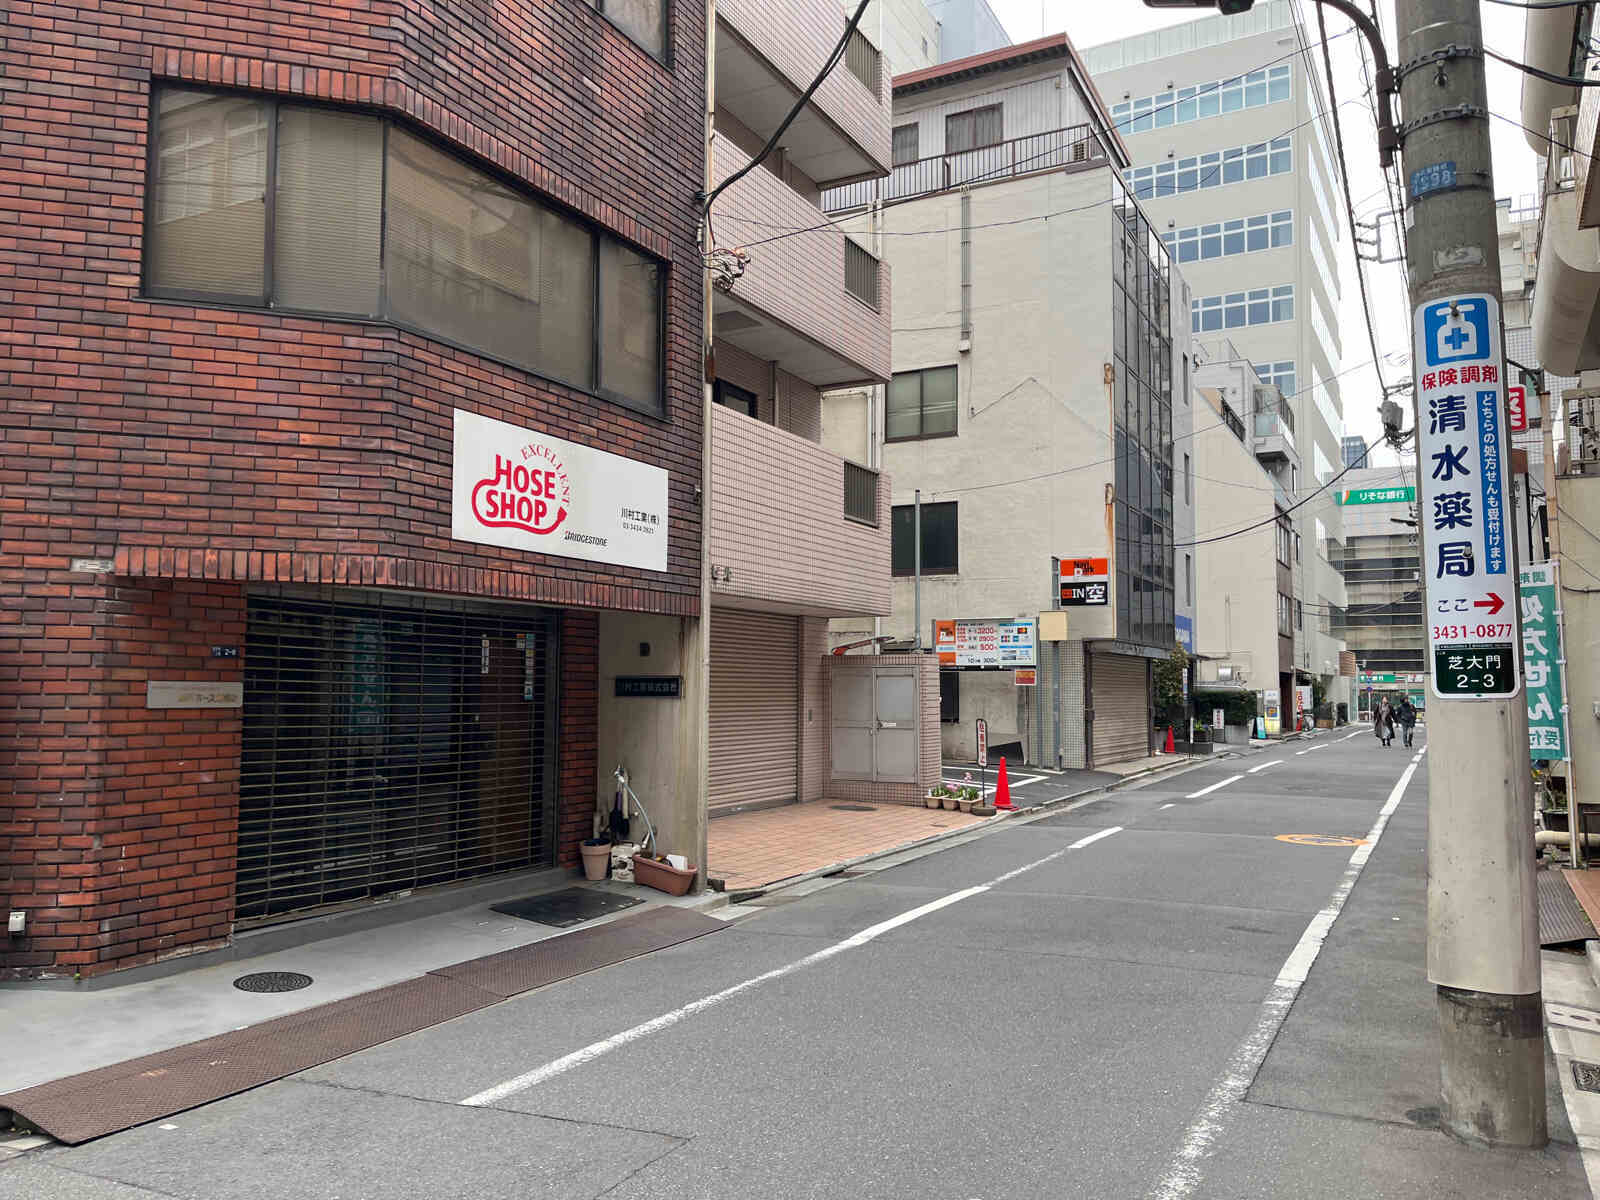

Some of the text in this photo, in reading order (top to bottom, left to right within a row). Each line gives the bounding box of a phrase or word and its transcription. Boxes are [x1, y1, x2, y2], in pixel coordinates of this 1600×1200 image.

[1421, 365, 1498, 391] 保険調剤
[494, 454, 556, 500] HOSE
[520, 443, 571, 504] EXCELLENT
[1481, 393, 1503, 572] どちらの処方せんも受付けます
[1359, 489, 1405, 501] りそな銀行
[1429, 395, 1475, 579] 清水薬局
[485, 489, 547, 526] SHOP
[564, 530, 608, 547] BRIDGESTONE
[1072, 588, 1085, 599] IN
[1086, 584, 1105, 603] 空
[1437, 598, 1469, 613] ここ
[1433, 623, 1512, 640] 3431-0877
[1448, 655, 1501, 670] 芝大門
[1456, 673, 1495, 688] 2-3
